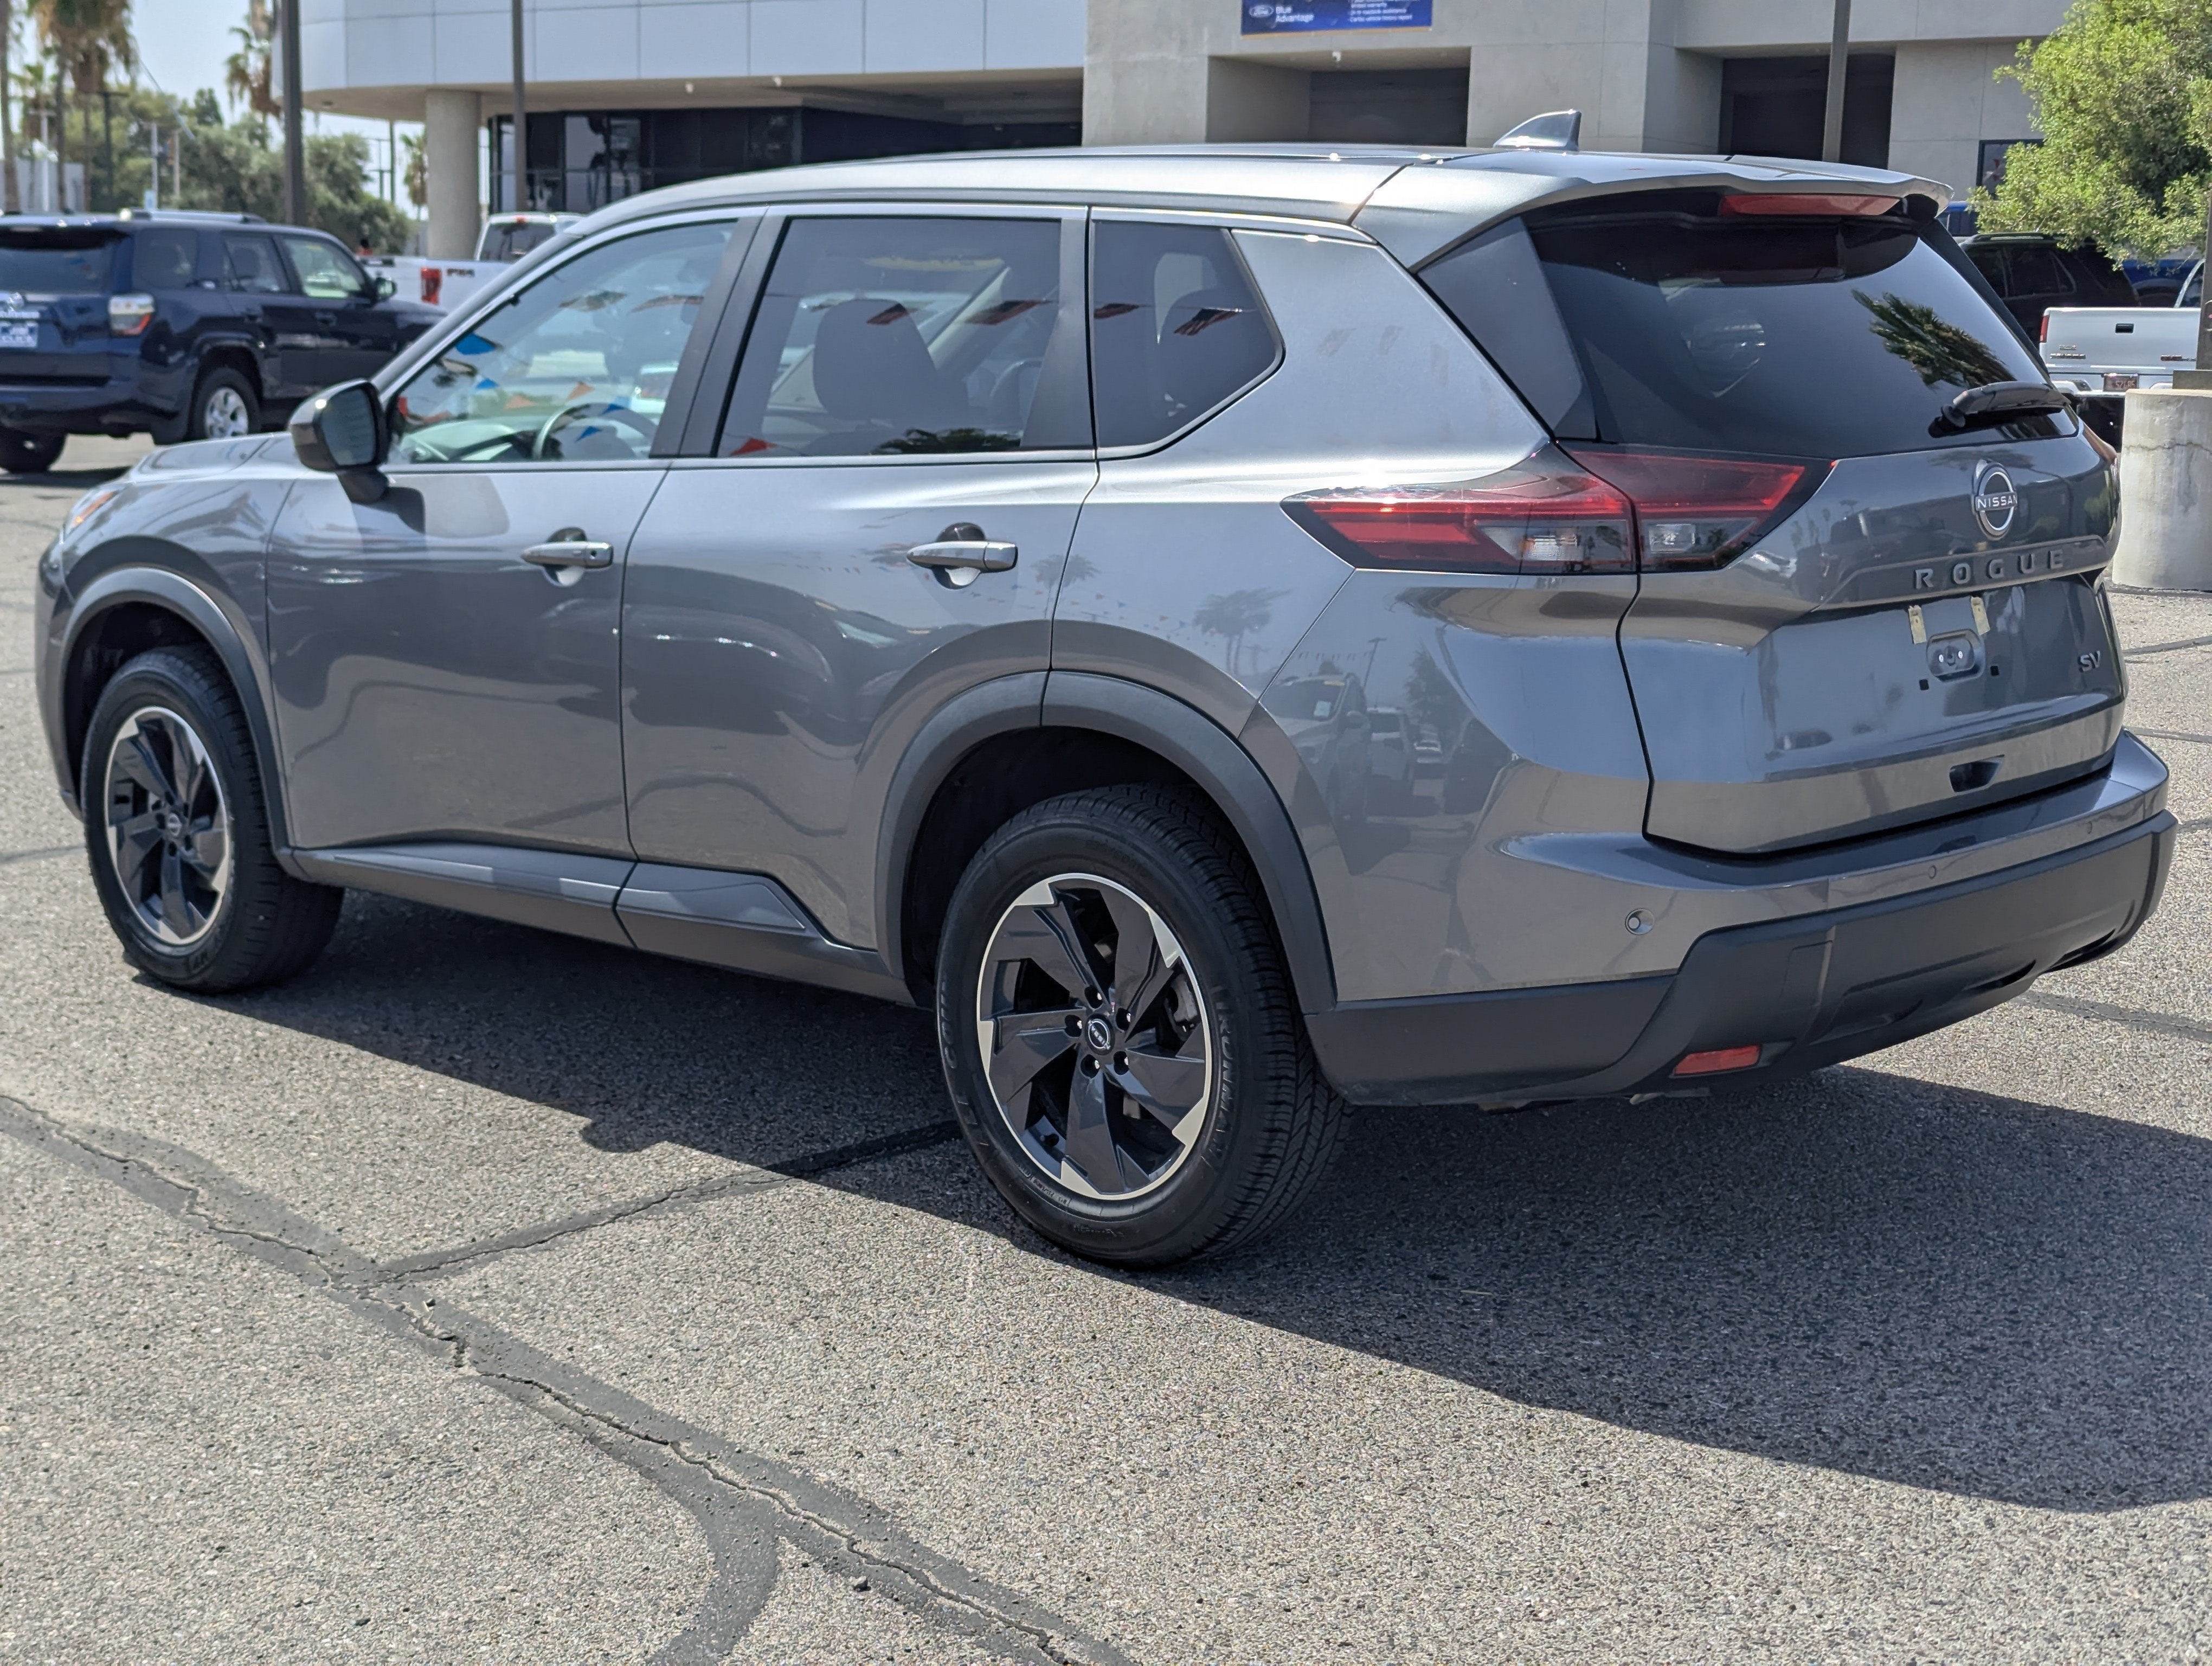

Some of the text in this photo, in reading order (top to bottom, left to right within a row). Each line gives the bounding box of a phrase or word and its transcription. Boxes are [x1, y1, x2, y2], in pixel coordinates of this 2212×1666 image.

[1977, 495, 2018, 509] NISSAN
[1914, 549, 2063, 590] ROGUE
[2078, 650, 2101, 672] SV
[1088, 1020, 1111, 1050] NISSAN
